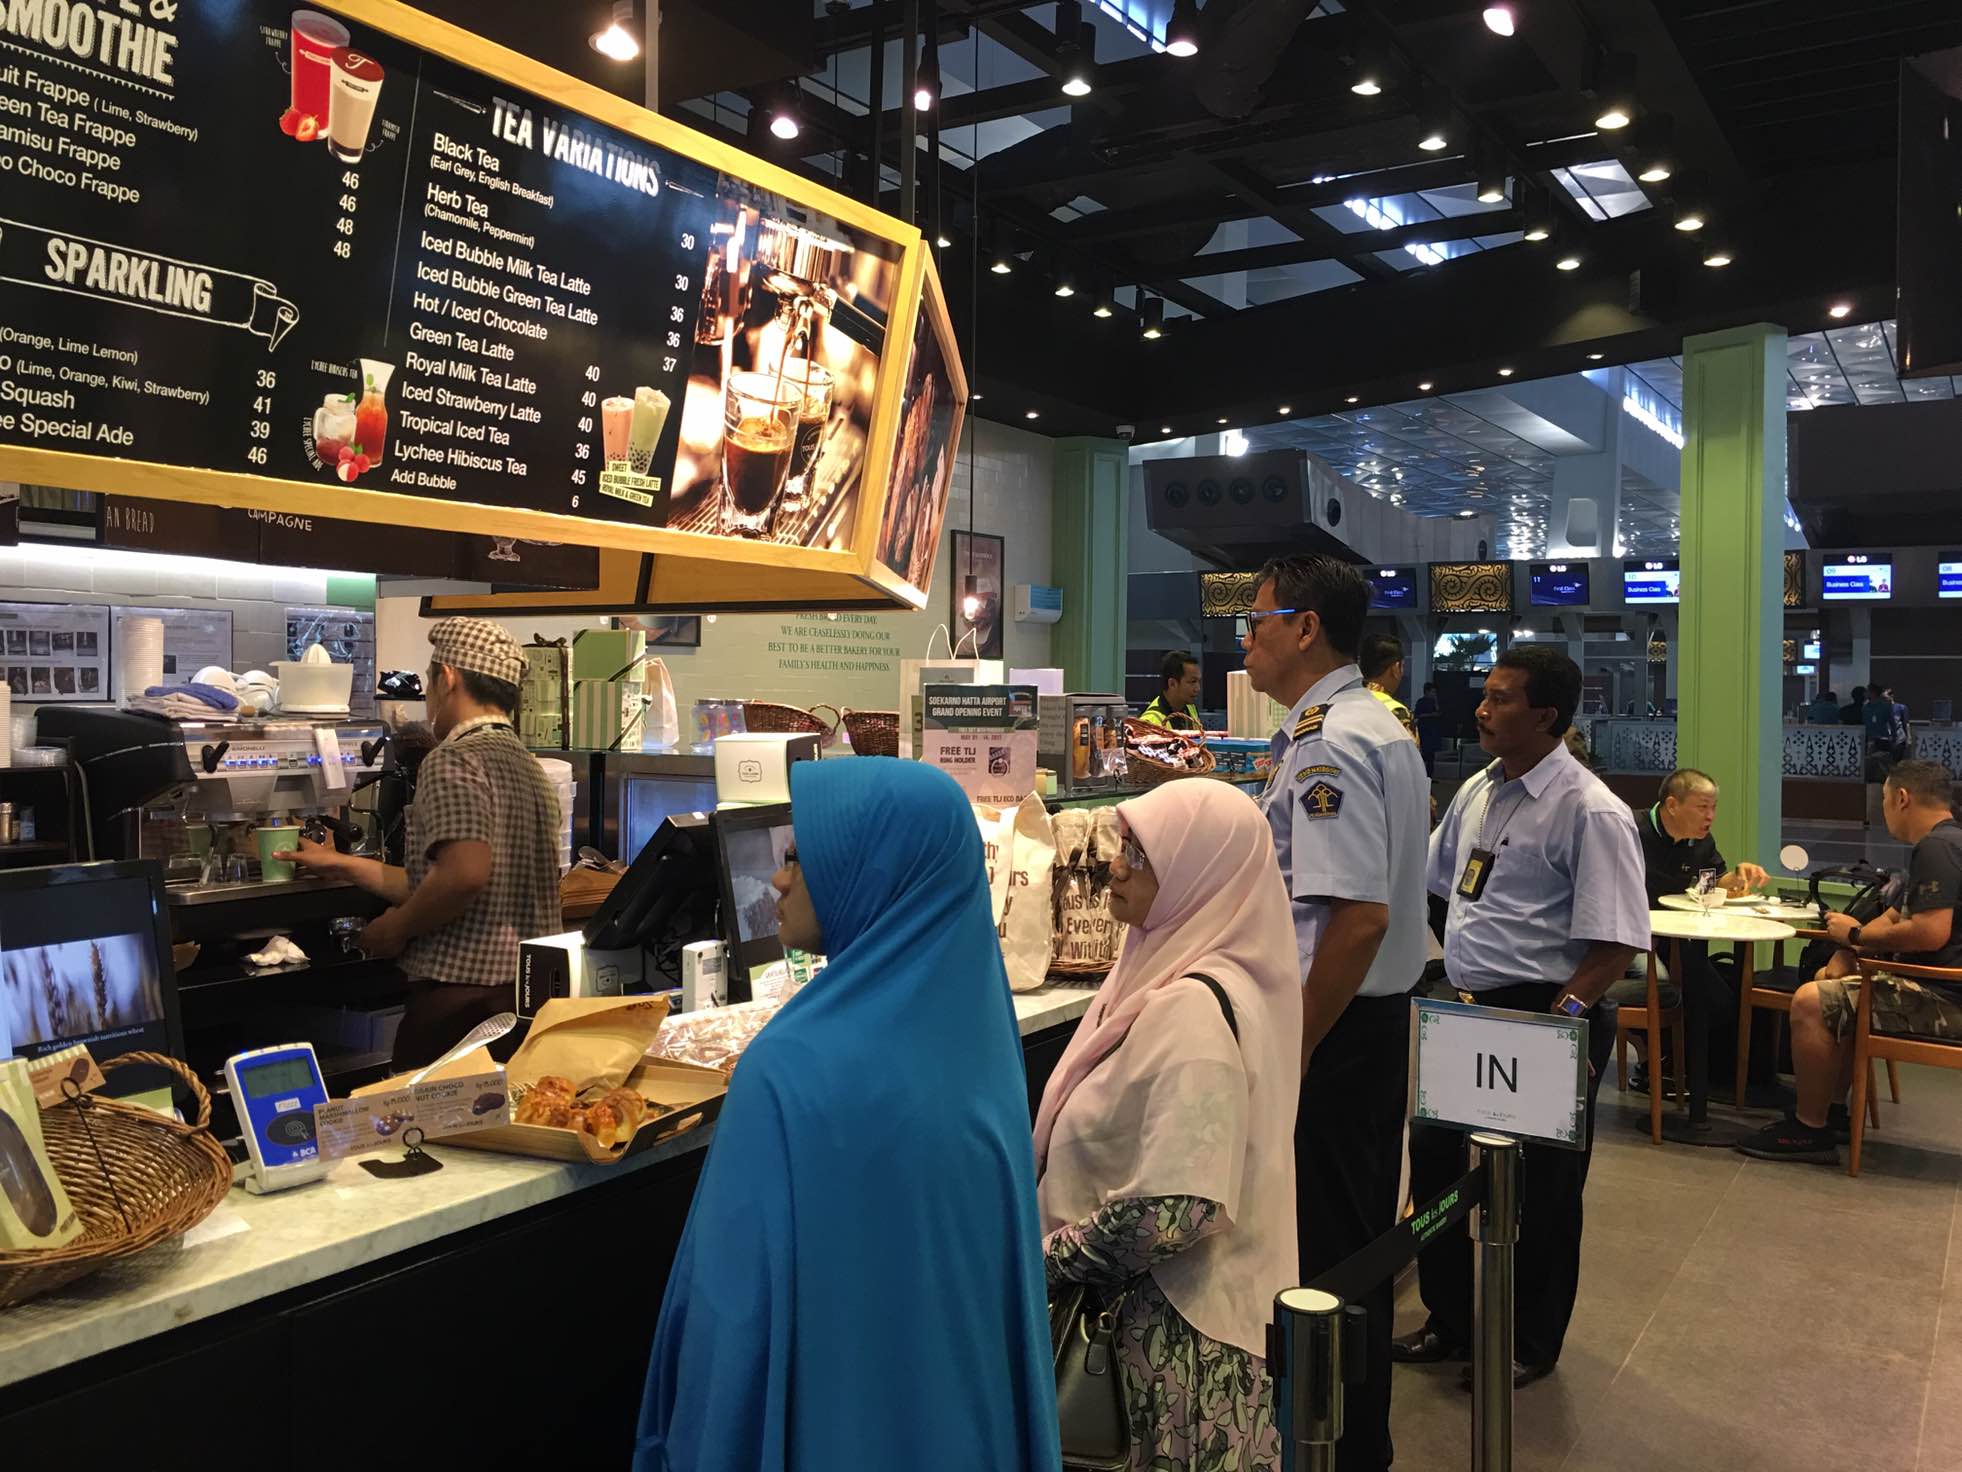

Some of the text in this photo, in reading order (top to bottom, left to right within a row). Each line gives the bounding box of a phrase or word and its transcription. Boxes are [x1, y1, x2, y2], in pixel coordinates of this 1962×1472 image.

[0, 0, 178, 87] MOOTHIE
[25, 70, 90, 107] Frappe
[135, 110, 199, 143] Strawberry)
[37, 101, 69, 129] Tea
[74, 113, 137, 147] Frappe
[57, 136, 121, 170] Frappe
[433, 132, 500, 172] Black Tea
[492, 96, 662, 197] TEA VARIATIONS
[18, 155, 140, 203] Choco Frappe
[342, 171, 359, 190] 46
[430, 154, 554, 210] (Earl Grey, English Breakfast)
[339, 194, 357, 213] 46
[427, 182, 489, 218] Herb Tea
[336, 217, 353, 235] 48
[424, 203, 535, 250] (Chamomile, Peppermint)
[333, 241, 351, 258] 48
[681, 233, 695, 250] 30
[420, 230, 592, 296] Iced Bubble Milk Tea Latte
[44, 237, 213, 313] SPARKLING
[675, 274, 689, 291] 30
[417, 261, 599, 326] Iced Bubble Green Tea Latte
[413, 291, 439, 314] Hot
[451, 301, 481, 324] Iced
[483, 309, 549, 341] Chocolate
[670, 306, 684, 323] 36
[409, 322, 515, 362] Green Tea Latte
[666, 331, 680, 348] 36
[58, 337, 89, 355] Lime
[93, 344, 138, 366] Lemon)
[405, 351, 537, 395] Royal Milk Tea Latte
[585, 365, 600, 382] 40
[663, 356, 677, 373] 37
[16, 359, 56, 380] (Lime,
[59, 366, 109, 388] Orange,
[112, 375, 141, 393] Kiwi,
[144, 381, 210, 405] Strawberry)
[256, 369, 276, 389] 36
[0, 380, 75, 409] Squash
[253, 396, 271, 415] 41
[402, 381, 542, 423] Iced Strawberry Latte
[581, 391, 597, 408] 40
[20, 412, 134, 446] Special Ade
[250, 420, 270, 439] 39
[399, 410, 510, 446] Tropical Iced Tea
[578, 416, 593, 433] 40
[247, 446, 267, 465] 46
[394, 439, 528, 476] Lychee Hibiscus Tea
[575, 443, 590, 460] 36
[390, 468, 457, 490] Add Bubble
[571, 469, 586, 485] 45
[571, 495, 579, 508] 6
[125, 507, 155, 533] BREAD
[247, 509, 313, 532] CAMPAGNE
[780, 625, 793, 636] WE
[794, 626, 807, 637] ARE
[852, 630, 875, 641] DOING
[768, 642, 785, 652] BEST
[788, 642, 799, 653] TO
[800, 643, 809, 653] BE
[815, 644, 843, 655] BETTER
[843, 645, 868, 656] BAKERY
[868, 646, 881, 656] FOR
[881, 647, 901, 657] YOUR
[811, 660, 838, 671] HEALTH
[838, 661, 855, 671] AND
[855, 661, 890, 672] HAPPINESS
[928, 696, 1007, 706] SOEKARNO HATTA AIRPORT
[932, 707, 1003, 717] GRAND OPENING EVENT
[940, 746, 976, 756] FREE TLJ
[976, 795, 992, 803] FREE
[524, 985, 532, 1008] JOURS
[1476, 1052, 1518, 1093] IN
[300, 1146, 317, 1157] BCA
[1411, 1211, 1431, 1236] TOUS
[1438, 1189, 1460, 1216] JOURS
